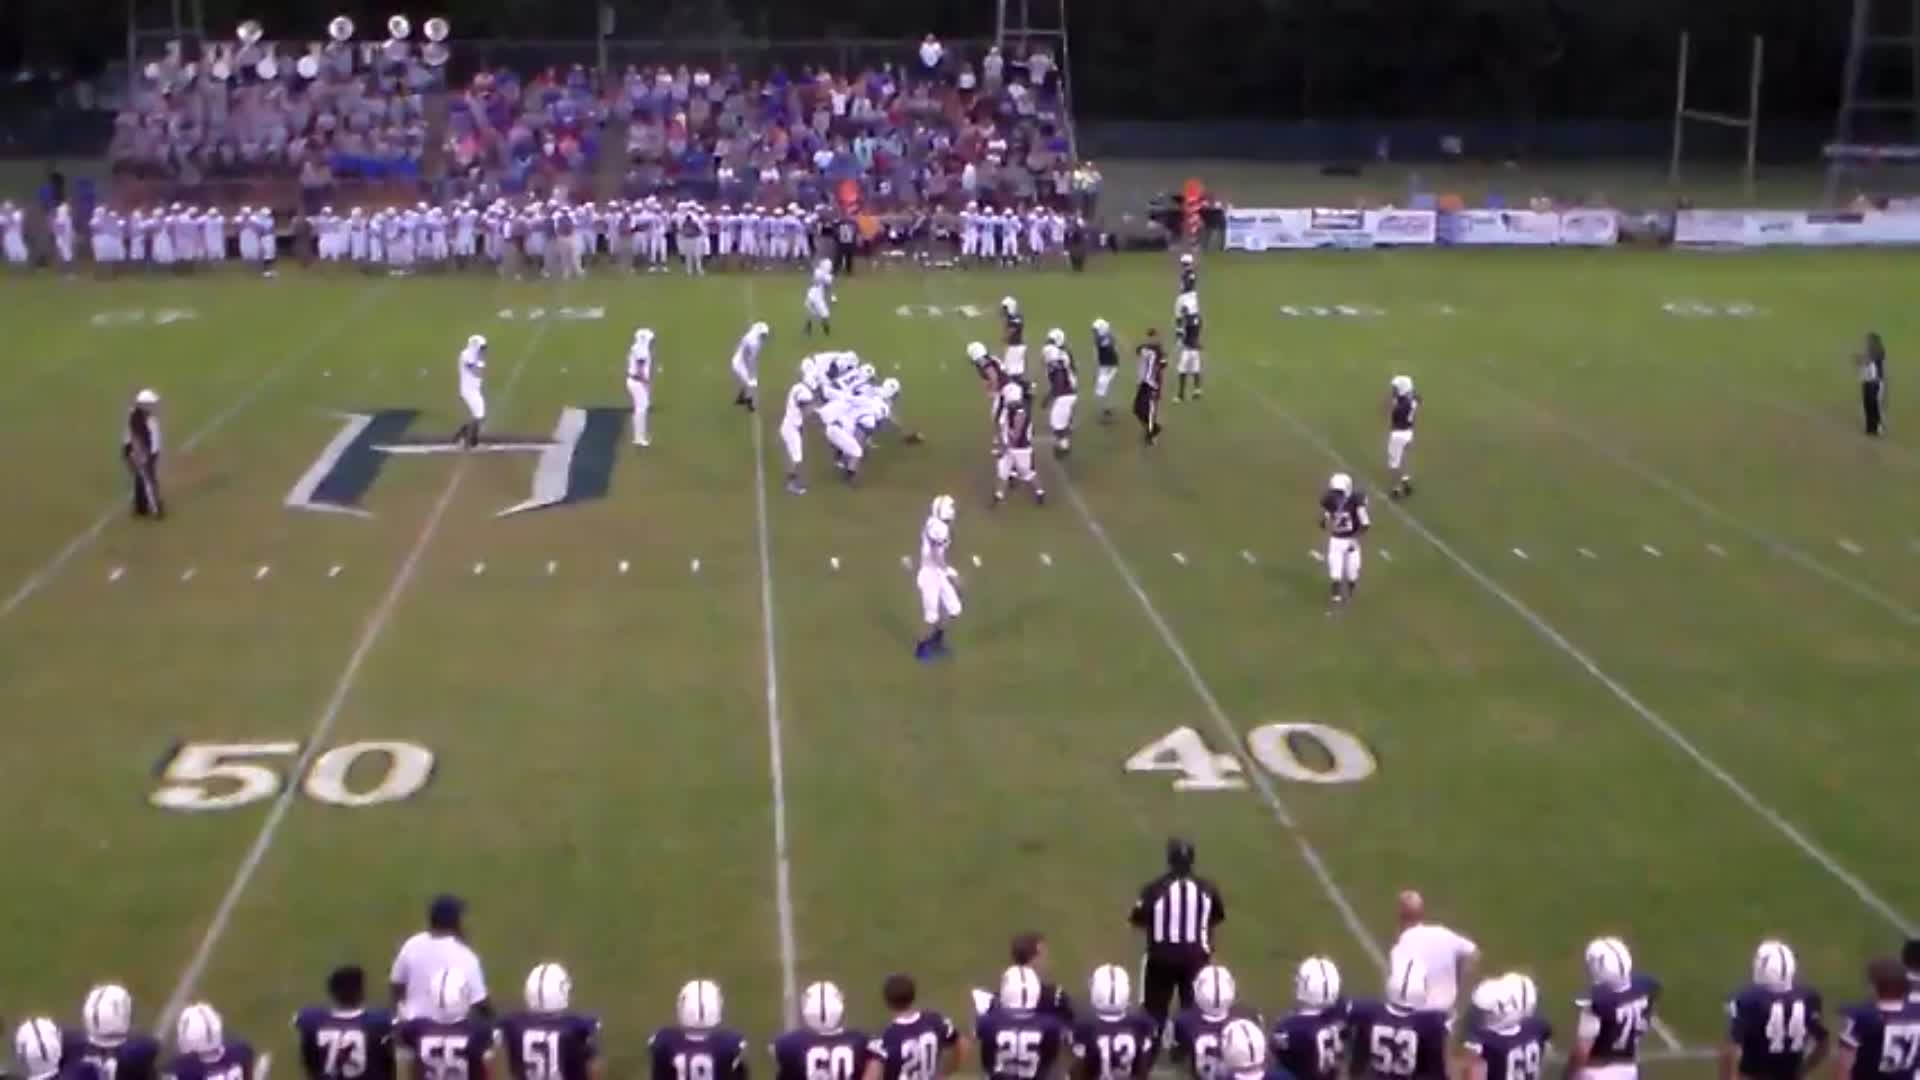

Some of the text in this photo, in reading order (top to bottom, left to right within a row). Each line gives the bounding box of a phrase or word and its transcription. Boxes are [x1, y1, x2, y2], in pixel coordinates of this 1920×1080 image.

[151, 741, 434, 808] 50
[1124, 723, 1378, 790] 40
[1370, 1025, 1417, 1076] 53
[1766, 1001, 1806, 1053] 44
[1878, 1024, 1920, 1072] 57
[317, 1029, 367, 1078] 73
[420, 1036, 469, 1080] 55
[522, 1029, 562, 1080] 51
[900, 1031, 938, 1080] 20
[995, 1030, 1042, 1078] 25
[1097, 1033, 1136, 1080] 13
